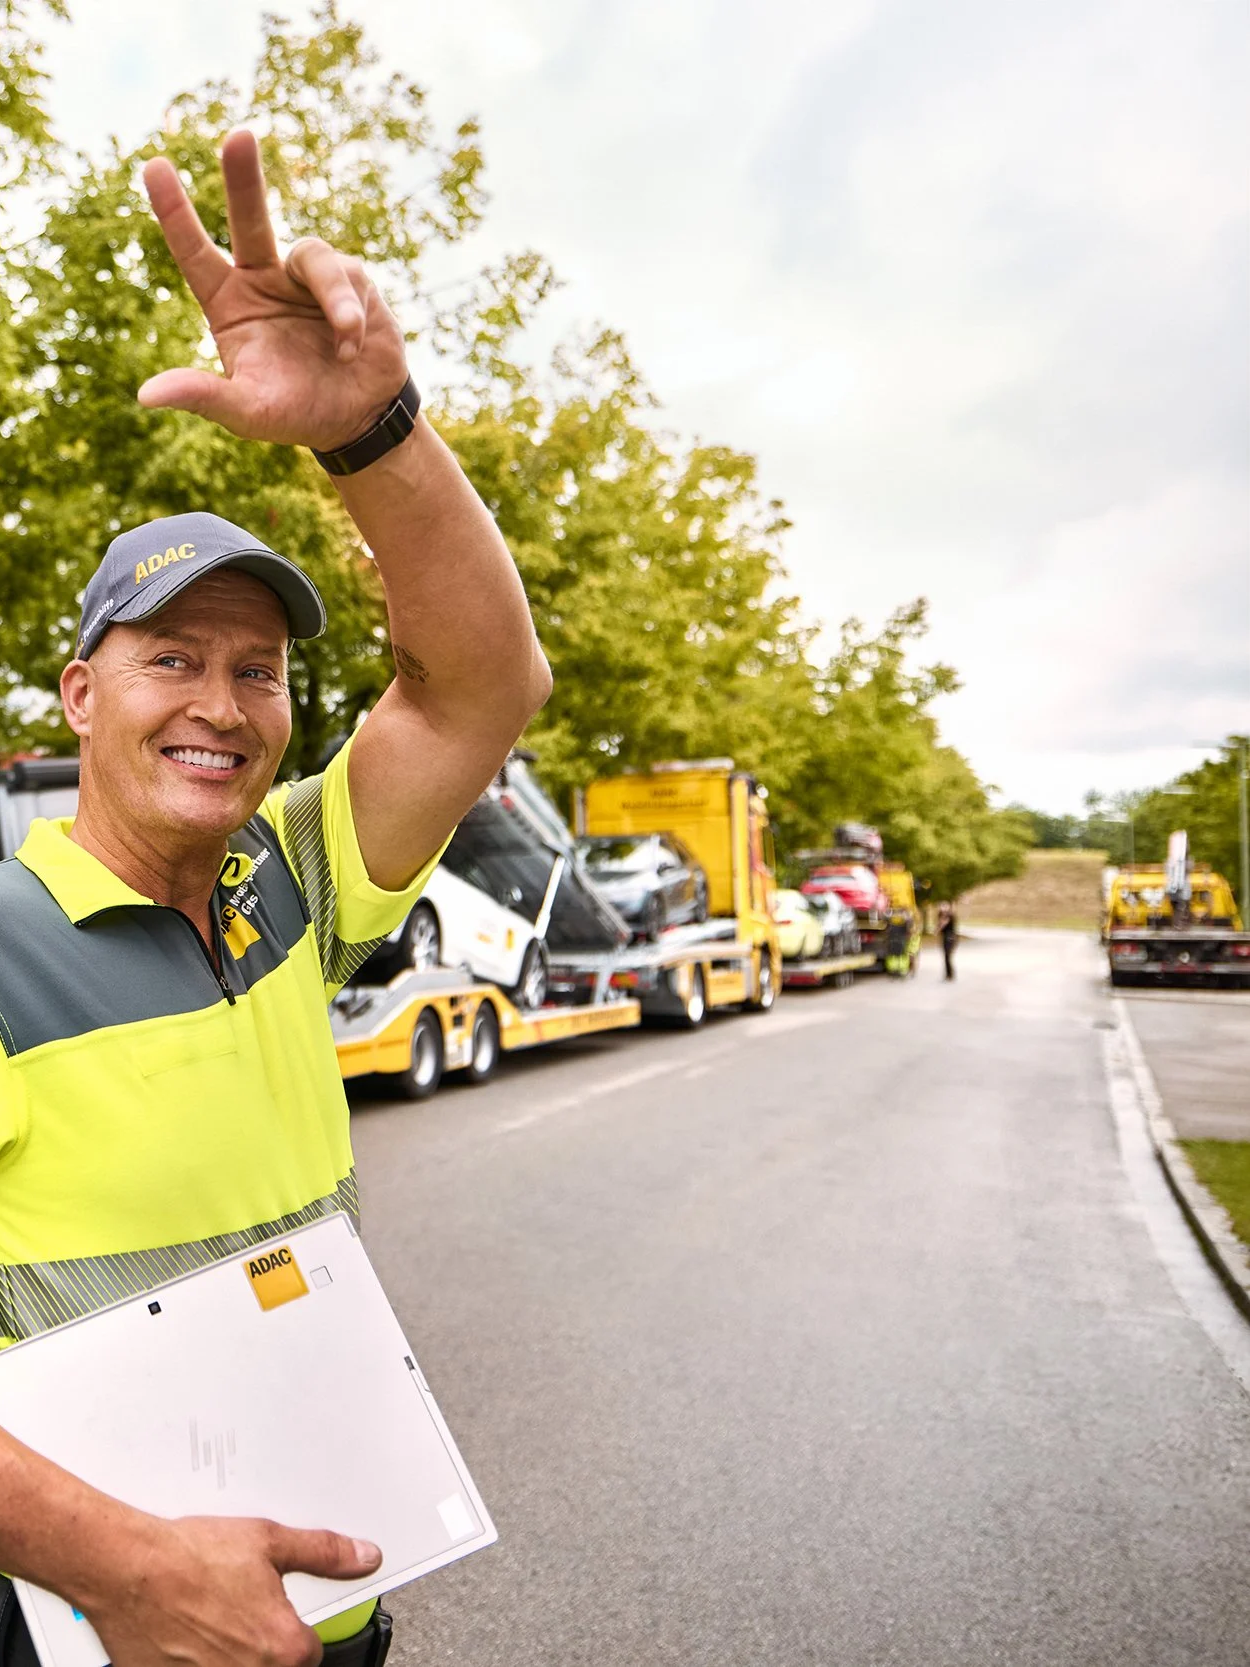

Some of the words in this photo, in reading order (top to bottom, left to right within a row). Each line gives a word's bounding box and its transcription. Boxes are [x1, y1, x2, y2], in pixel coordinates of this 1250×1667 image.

[134, 543, 197, 586] ADAC
[220, 907, 237, 935] AC
[248, 1248, 292, 1279] ADAC
